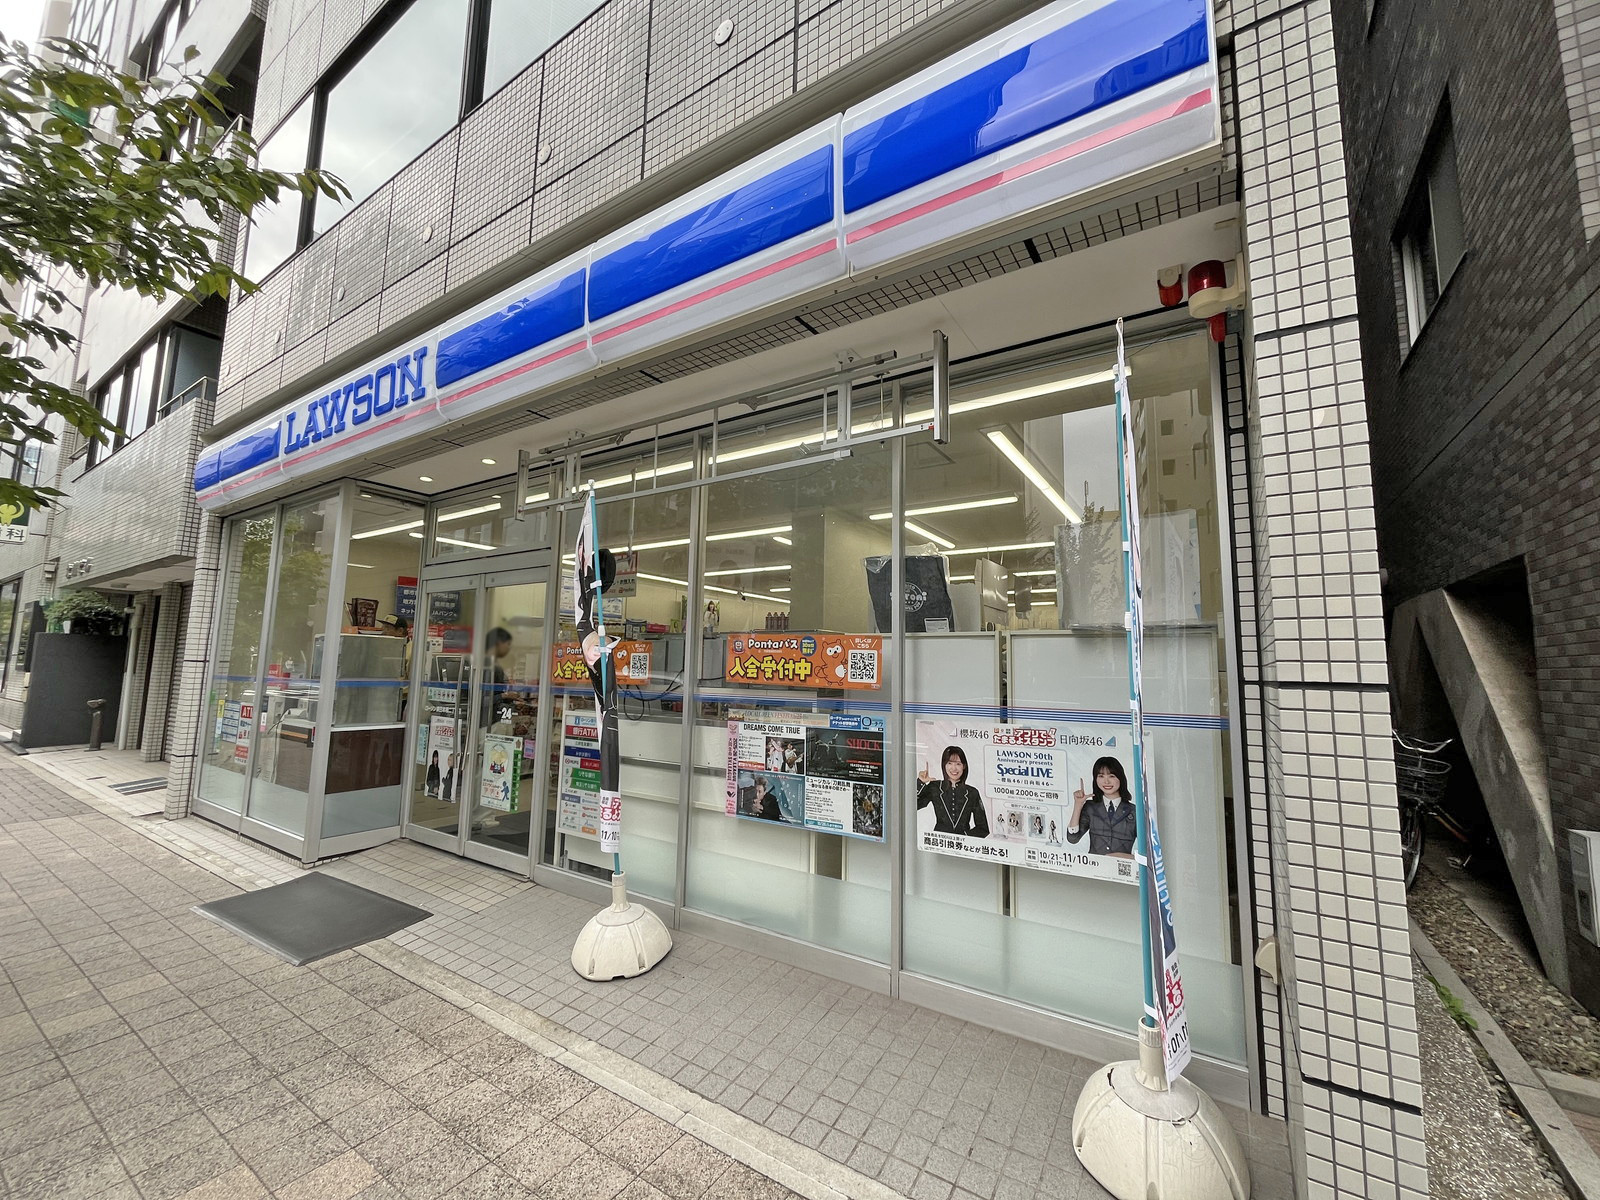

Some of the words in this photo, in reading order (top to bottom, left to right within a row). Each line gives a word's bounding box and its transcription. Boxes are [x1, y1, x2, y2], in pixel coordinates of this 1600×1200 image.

[284, 346, 427, 454] LAWSON
[0, 527, 25, 541] 科
[748, 639, 798, 650] Pontaパス
[729, 656, 812, 682] 入会受付中
[501, 707, 512, 719] 24
[572, 726, 597, 737] 銀行ATM
[744, 723, 767, 732] DREAMS
[767, 725, 784, 733] COME
[785, 727, 800, 735] TRUE
[960, 728, 989, 739] 櫻坂46
[993, 735, 1056, 747] たまるよスタンプ
[1060, 735, 1103, 747] 日向坂46
[996, 750, 1032, 759] LAWSON
[1033, 752, 1053, 761] 50th
[997, 757, 1028, 765] Anniversary
[996, 763, 1029, 777] Special
[1030, 767, 1054, 779] LIVE
[923, 836, 1009, 858] 商品引換券などが当たる!
